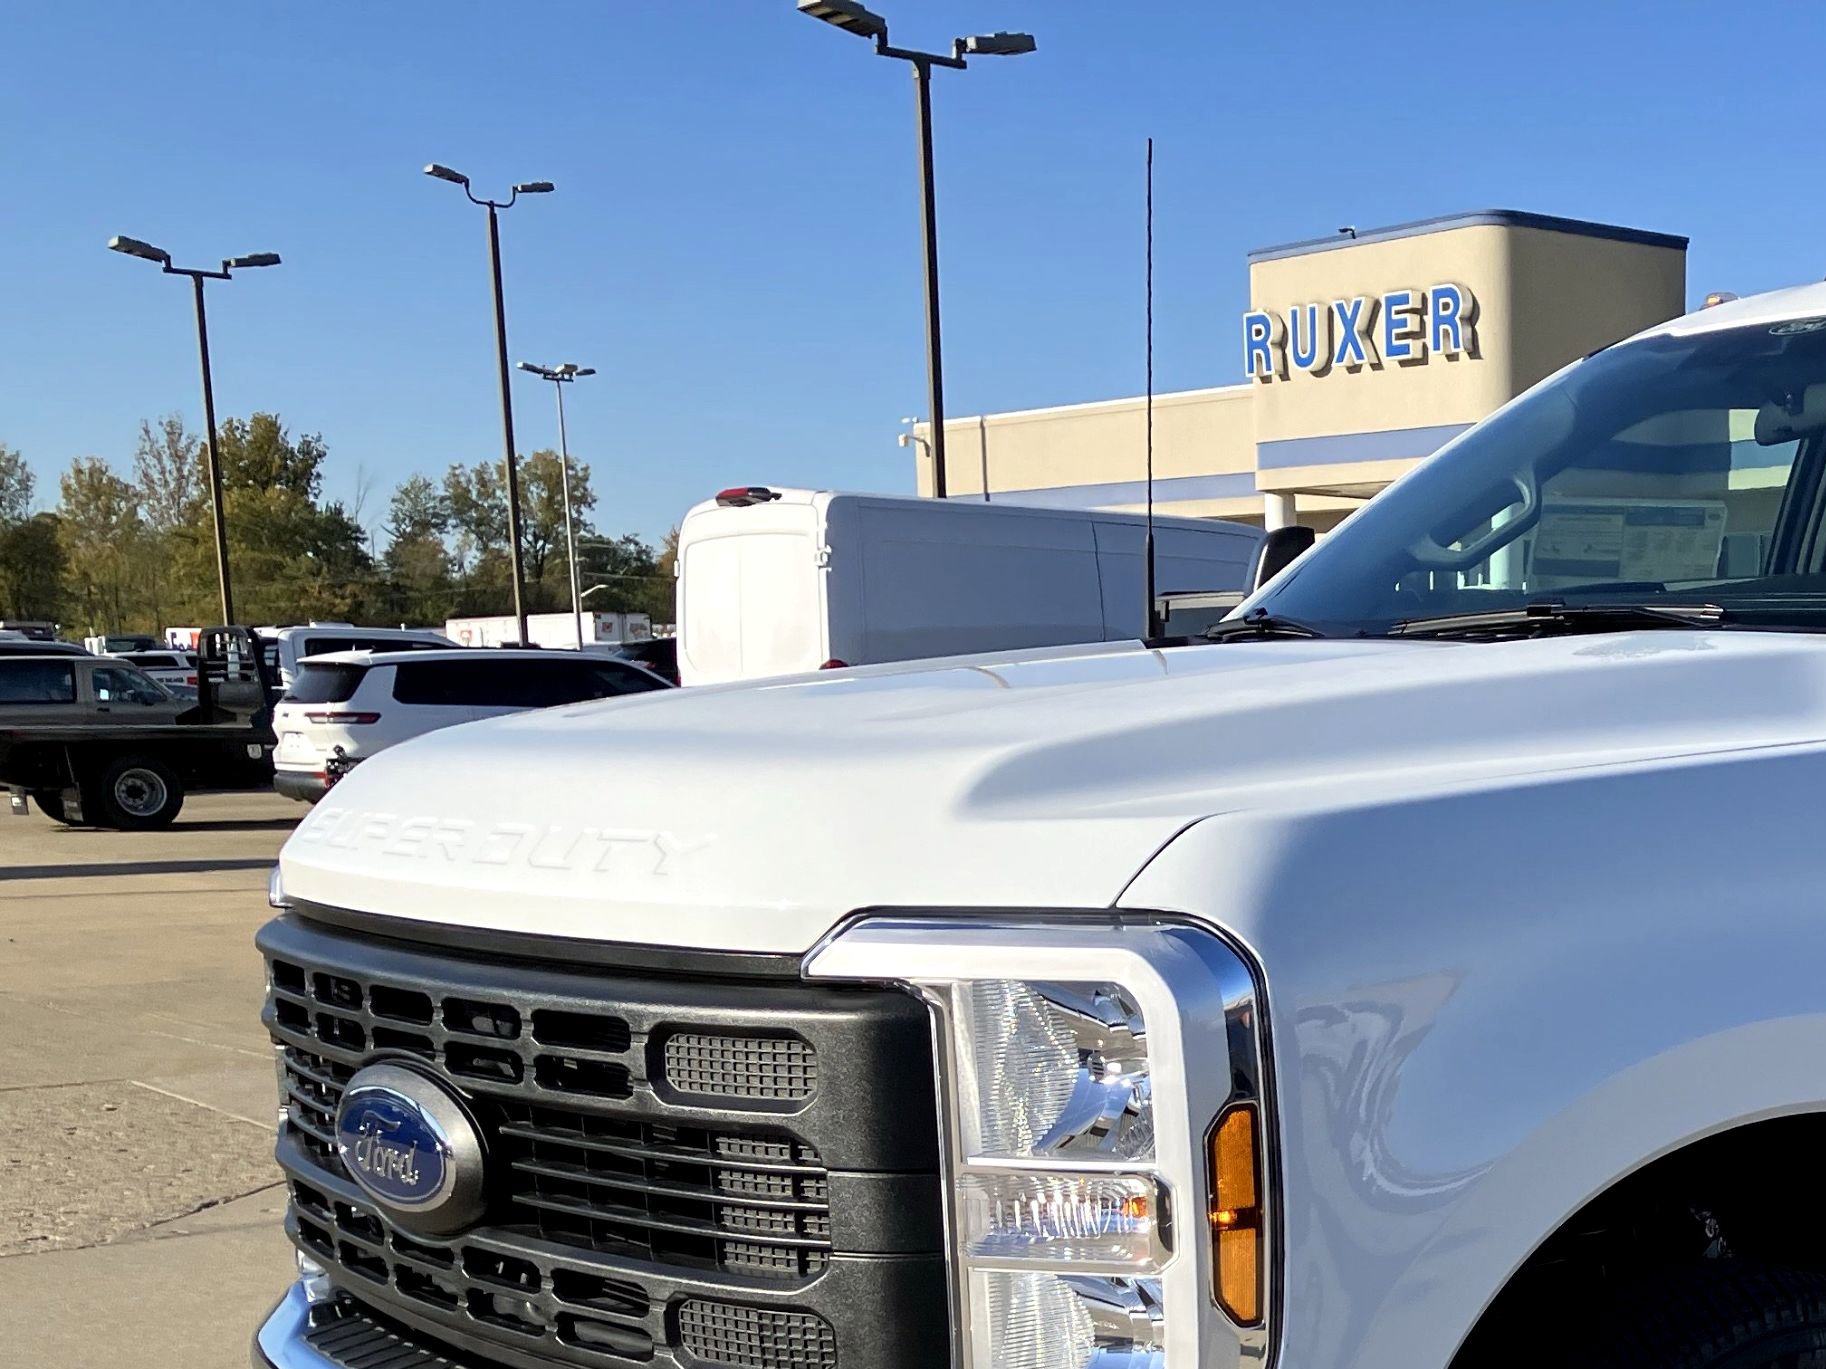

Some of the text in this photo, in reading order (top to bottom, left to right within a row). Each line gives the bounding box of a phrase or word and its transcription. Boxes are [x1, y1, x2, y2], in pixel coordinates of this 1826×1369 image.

[1242, 283, 1472, 378] RUXER
[303, 807, 719, 877] SUPER DUTY
[355, 1109, 420, 1186] Ford
